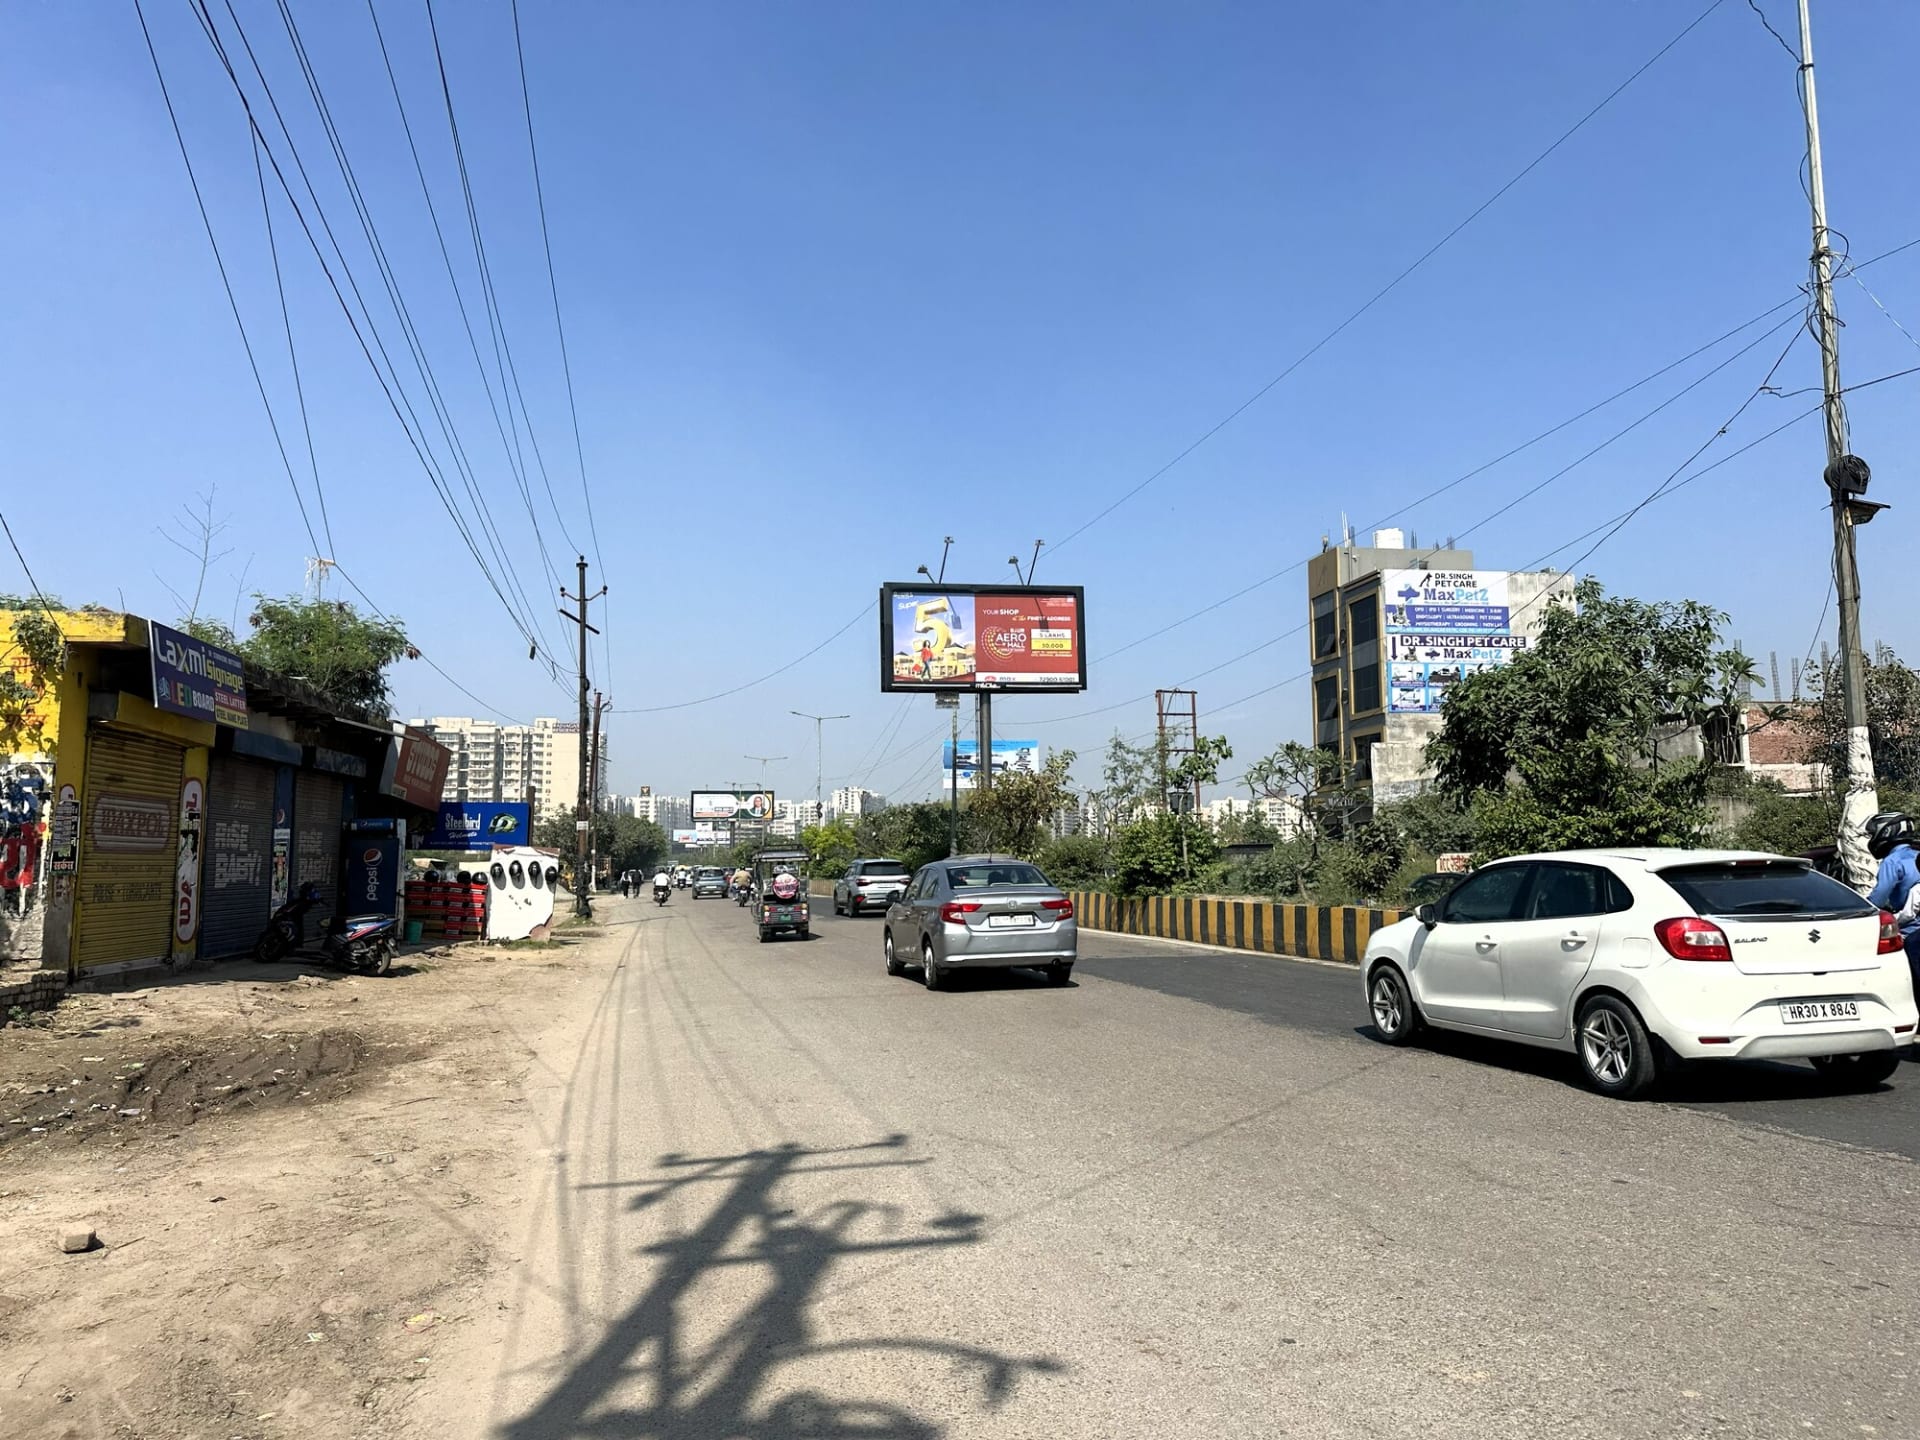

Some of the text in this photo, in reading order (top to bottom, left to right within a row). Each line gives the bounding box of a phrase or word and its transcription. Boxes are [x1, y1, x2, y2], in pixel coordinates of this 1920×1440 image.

[1434, 572, 1449, 580] DR.
[1434, 580, 1477, 588] PET CARE
[1424, 588, 1489, 601] MaxPetZ
[999, 608, 1020, 616] SHOP
[995, 633, 1027, 642] AERO
[1402, 636, 1525, 648] DR. SINGH PET CARE
[154, 627, 207, 678] Laxmi
[1443, 648, 1503, 660] MaxPetZ
[170, 680, 215, 712] LED BOARD
[445, 812, 481, 831] Steelbird
[366, 866, 379, 901] pepsi
[1734, 936, 1769, 944] BALENO
[1788, 1002, 1858, 1020] HR30 X 8849
